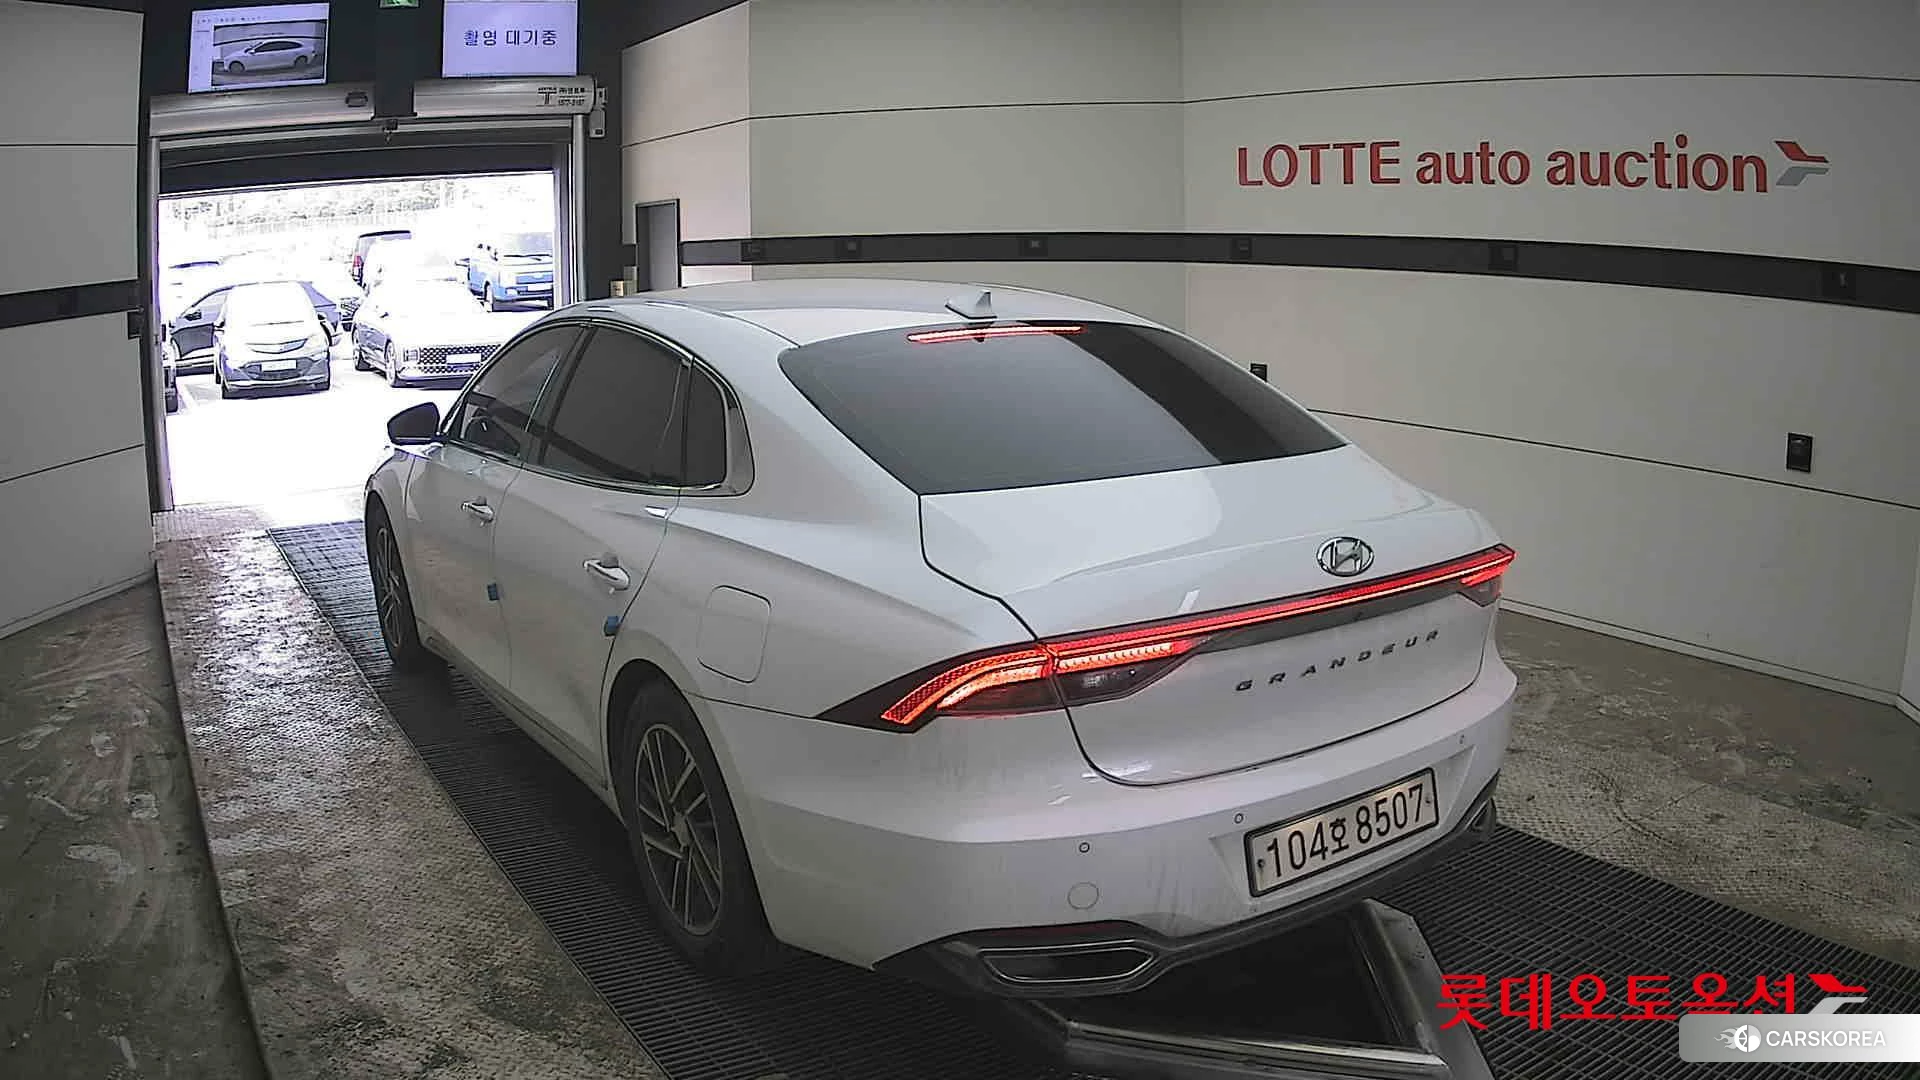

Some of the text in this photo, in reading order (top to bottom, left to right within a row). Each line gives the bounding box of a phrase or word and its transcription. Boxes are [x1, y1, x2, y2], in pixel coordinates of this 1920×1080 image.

[505, 29, 558, 46] 대기중
[1237, 133, 1769, 193] LOTTE auto auction
[1234, 629, 1439, 692] GRANDEUR
